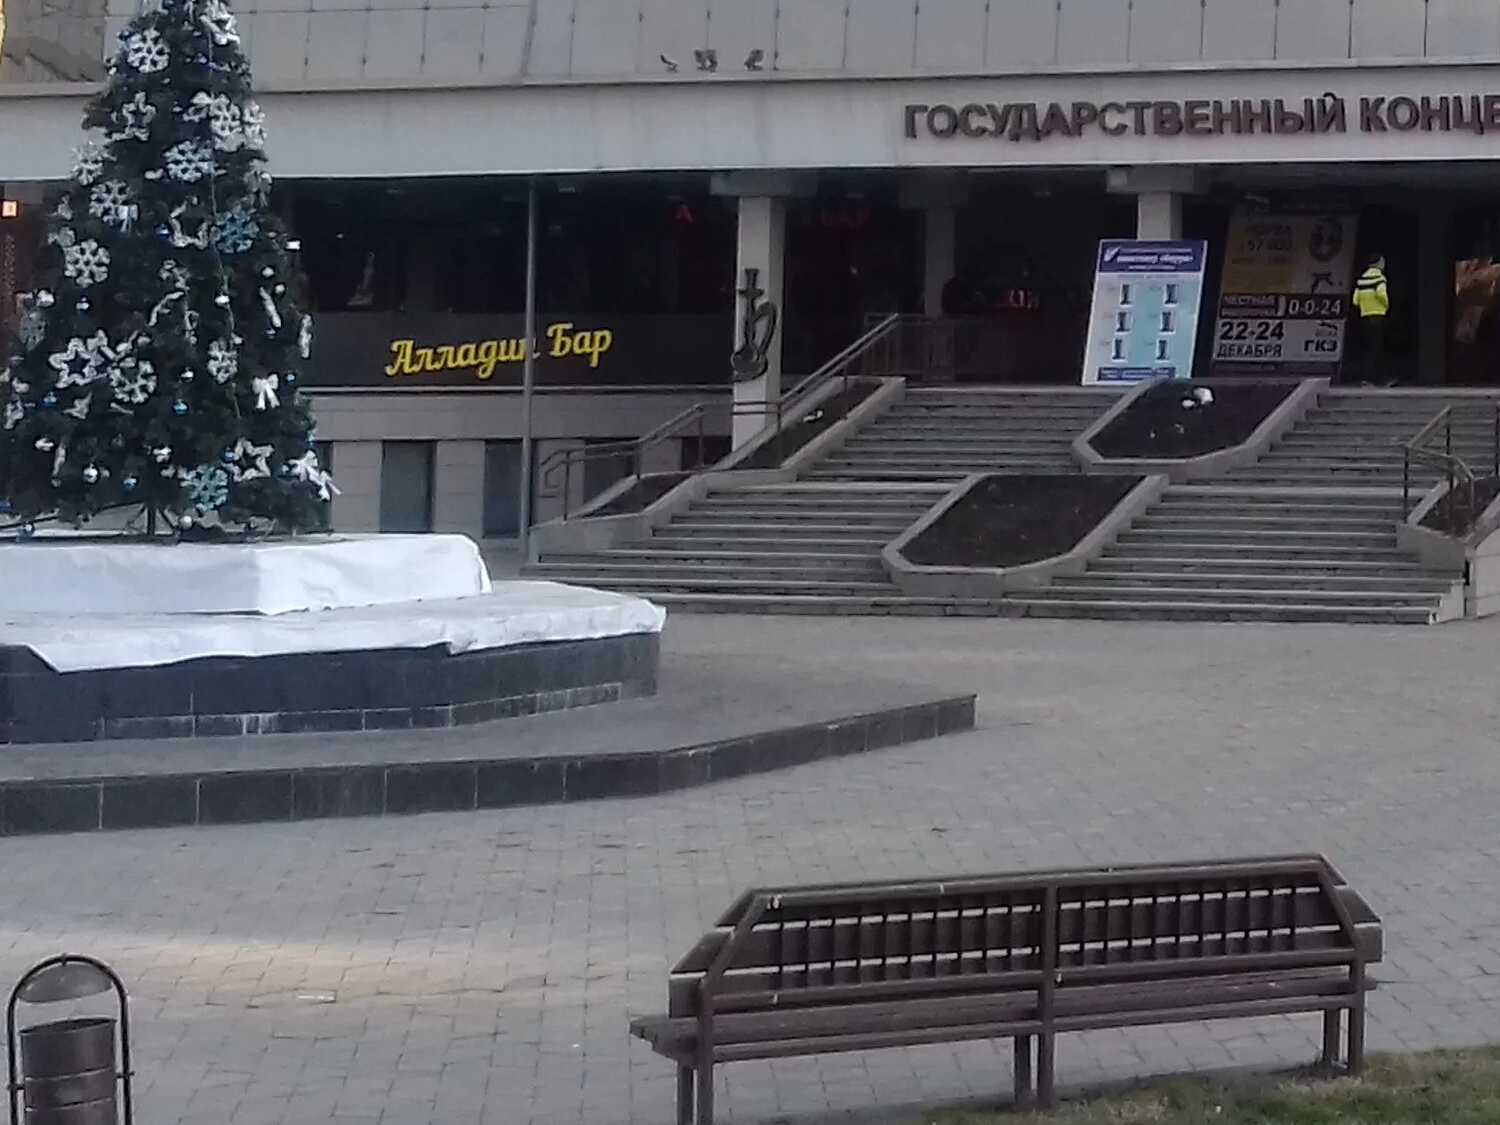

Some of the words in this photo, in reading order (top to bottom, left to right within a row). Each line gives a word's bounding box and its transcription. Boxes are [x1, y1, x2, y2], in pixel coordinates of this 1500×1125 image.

[905, 92, 1348, 141] ГОСУДАРСТВЕННЫЙ
[1288, 299, 1341, 315] 0-0-24
[1219, 321, 1285, 341] 22-24
[547, 322, 613, 368] Бар
[1217, 343, 1283, 358] ДЕКАБРЯ
[1303, 339, 1338, 352] ГКЗ
